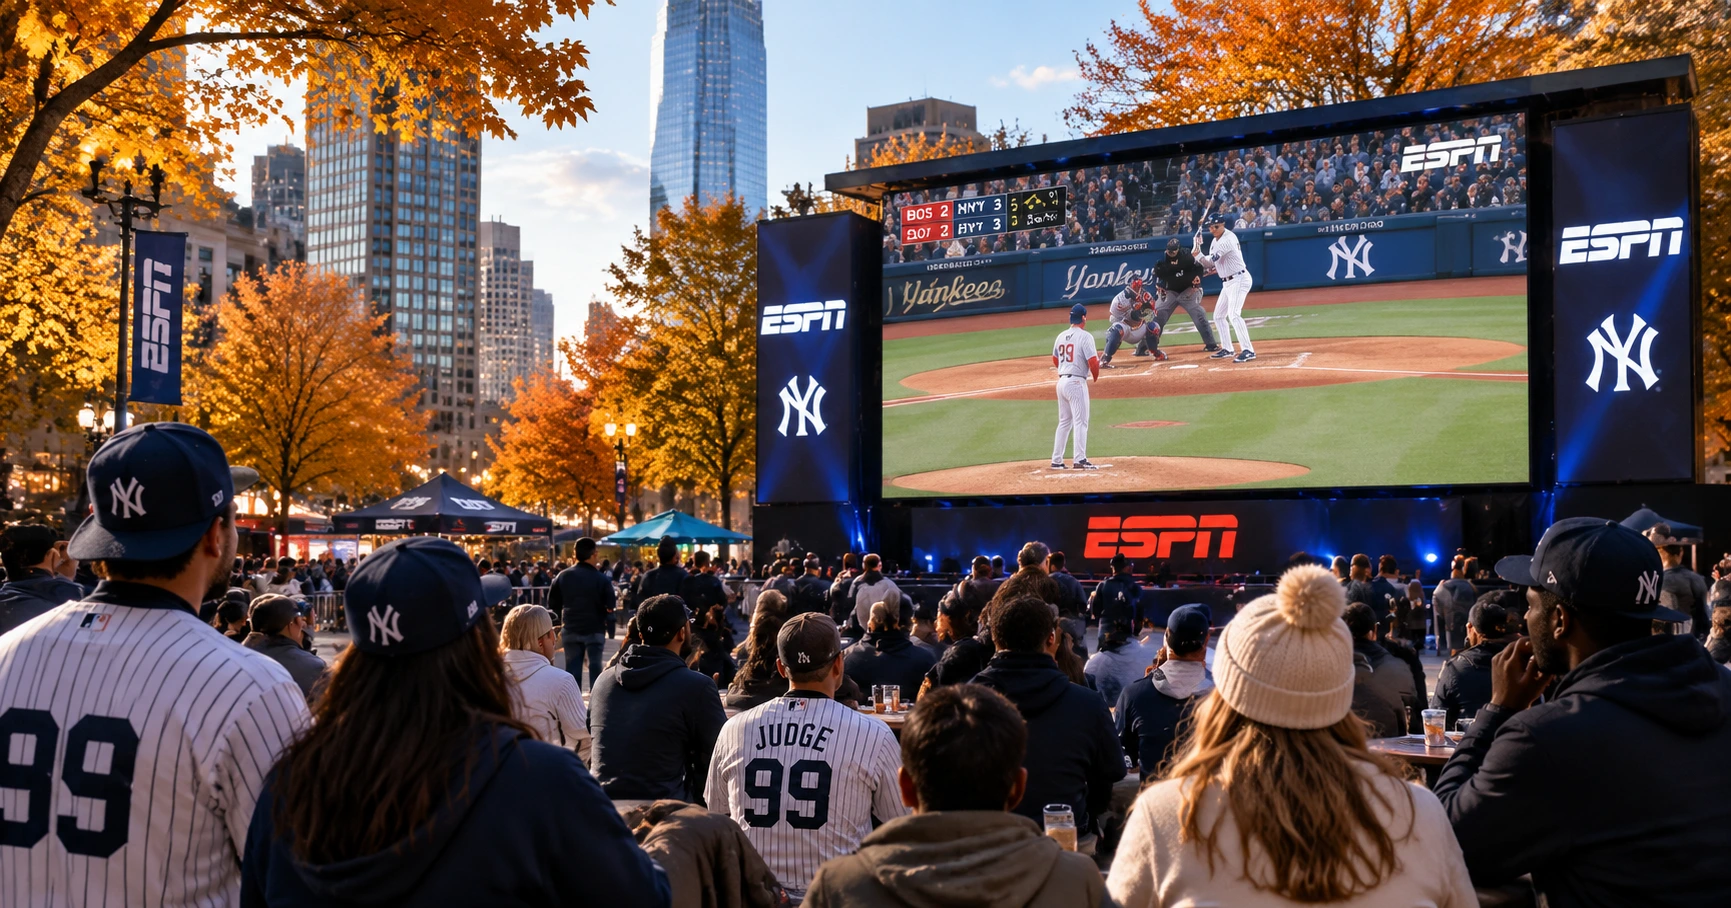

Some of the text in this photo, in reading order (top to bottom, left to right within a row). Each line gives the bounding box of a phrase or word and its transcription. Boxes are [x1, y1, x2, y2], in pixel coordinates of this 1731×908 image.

[1401, 134, 1502, 173] ESPN
[907, 207, 933, 221] BOS
[940, 205, 949, 217] 2
[993, 198, 1001, 211] 3
[940, 225, 949, 237] 2
[993, 218, 1001, 230] 3
[1326, 235, 1375, 280] NY
[1559, 216, 1684, 264] ESPN
[141, 257, 172, 374] ESPN
[761, 300, 847, 335] ESPN
[1585, 313, 1659, 392] NY
[777, 375, 827, 437] NY
[109, 477, 147, 518] NY
[1084, 514, 1239, 559] ESPN
[1635, 570, 1660, 604] NY
[367, 604, 404, 646] NY
[756, 722, 834, 752] JUDGE
[0, 707, 139, 858] 99
[744, 758, 832, 830] 99
